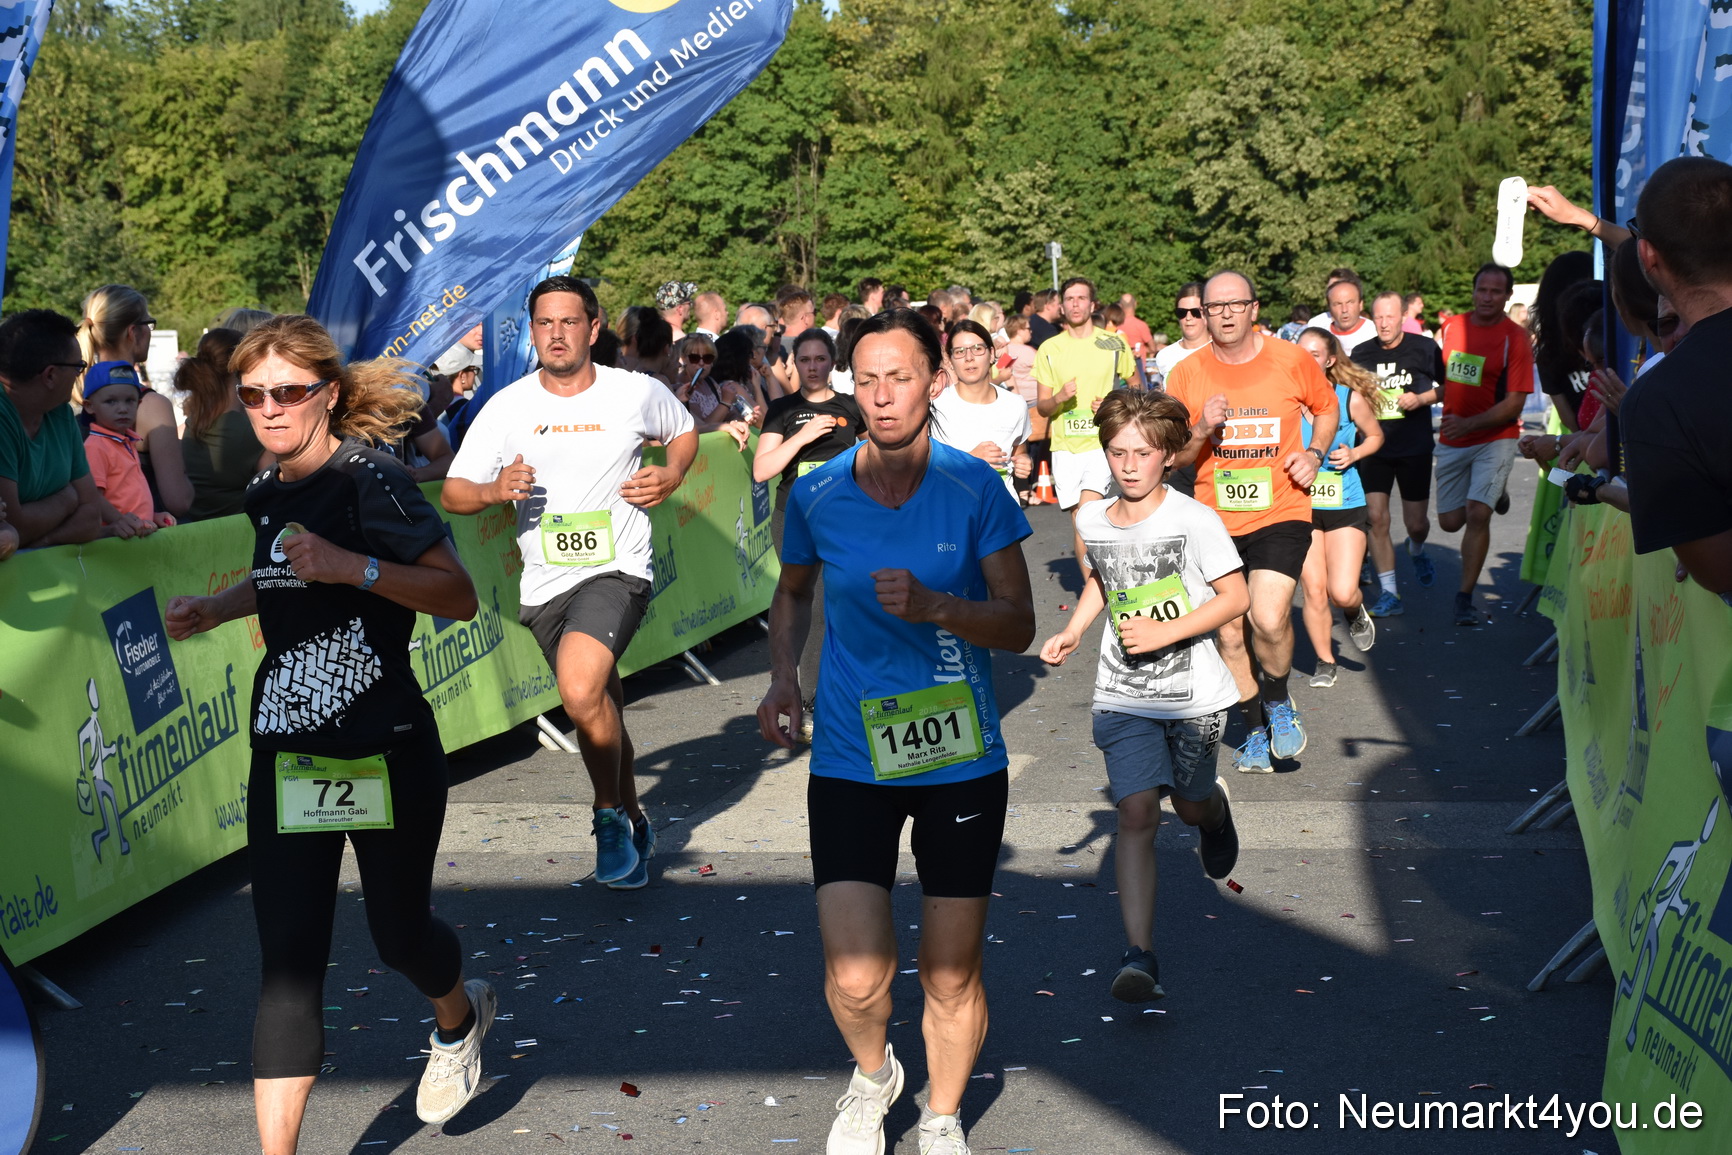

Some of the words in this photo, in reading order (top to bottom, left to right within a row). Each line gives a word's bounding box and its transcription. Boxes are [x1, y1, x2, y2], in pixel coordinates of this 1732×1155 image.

[549, 108, 624, 175] Druck
[622, 61, 672, 112] und
[353, 28, 652, 297] Frischmann
[1450, 361, 1477, 378] 1158
[1239, 406, 1268, 417] Jahre
[552, 423, 606, 433] KLEBL
[1067, 419, 1095, 430] 1625
[1215, 423, 1274, 440] OBI
[1212, 446, 1279, 459] Neumarkt
[818, 476, 833, 488] JAKO
[1226, 484, 1259, 499] 902
[556, 531, 598, 552] 886
[937, 542, 956, 553] Rita
[421, 584, 504, 690] firmenlauf
[124, 632, 159, 667] Fischer
[134, 653, 161, 677] AUTOMOBILE
[430, 671, 472, 711] neumarkt
[117, 662, 240, 812] firmenlauf
[881, 711, 961, 755] 1401
[898, 760, 921, 770] Nathalie
[922, 750, 958, 765] Lengenfelder
[907, 751, 929, 761] Marx
[929, 746, 947, 756] Rita
[313, 779, 356, 807] 72
[133, 781, 184, 840] neumarkt
[303, 809, 346, 818] Hoffmann
[348, 807, 368, 816] Gabi
[318, 816, 354, 824] Bärnreuther
[1641, 1026, 1699, 1095] neumarkt
